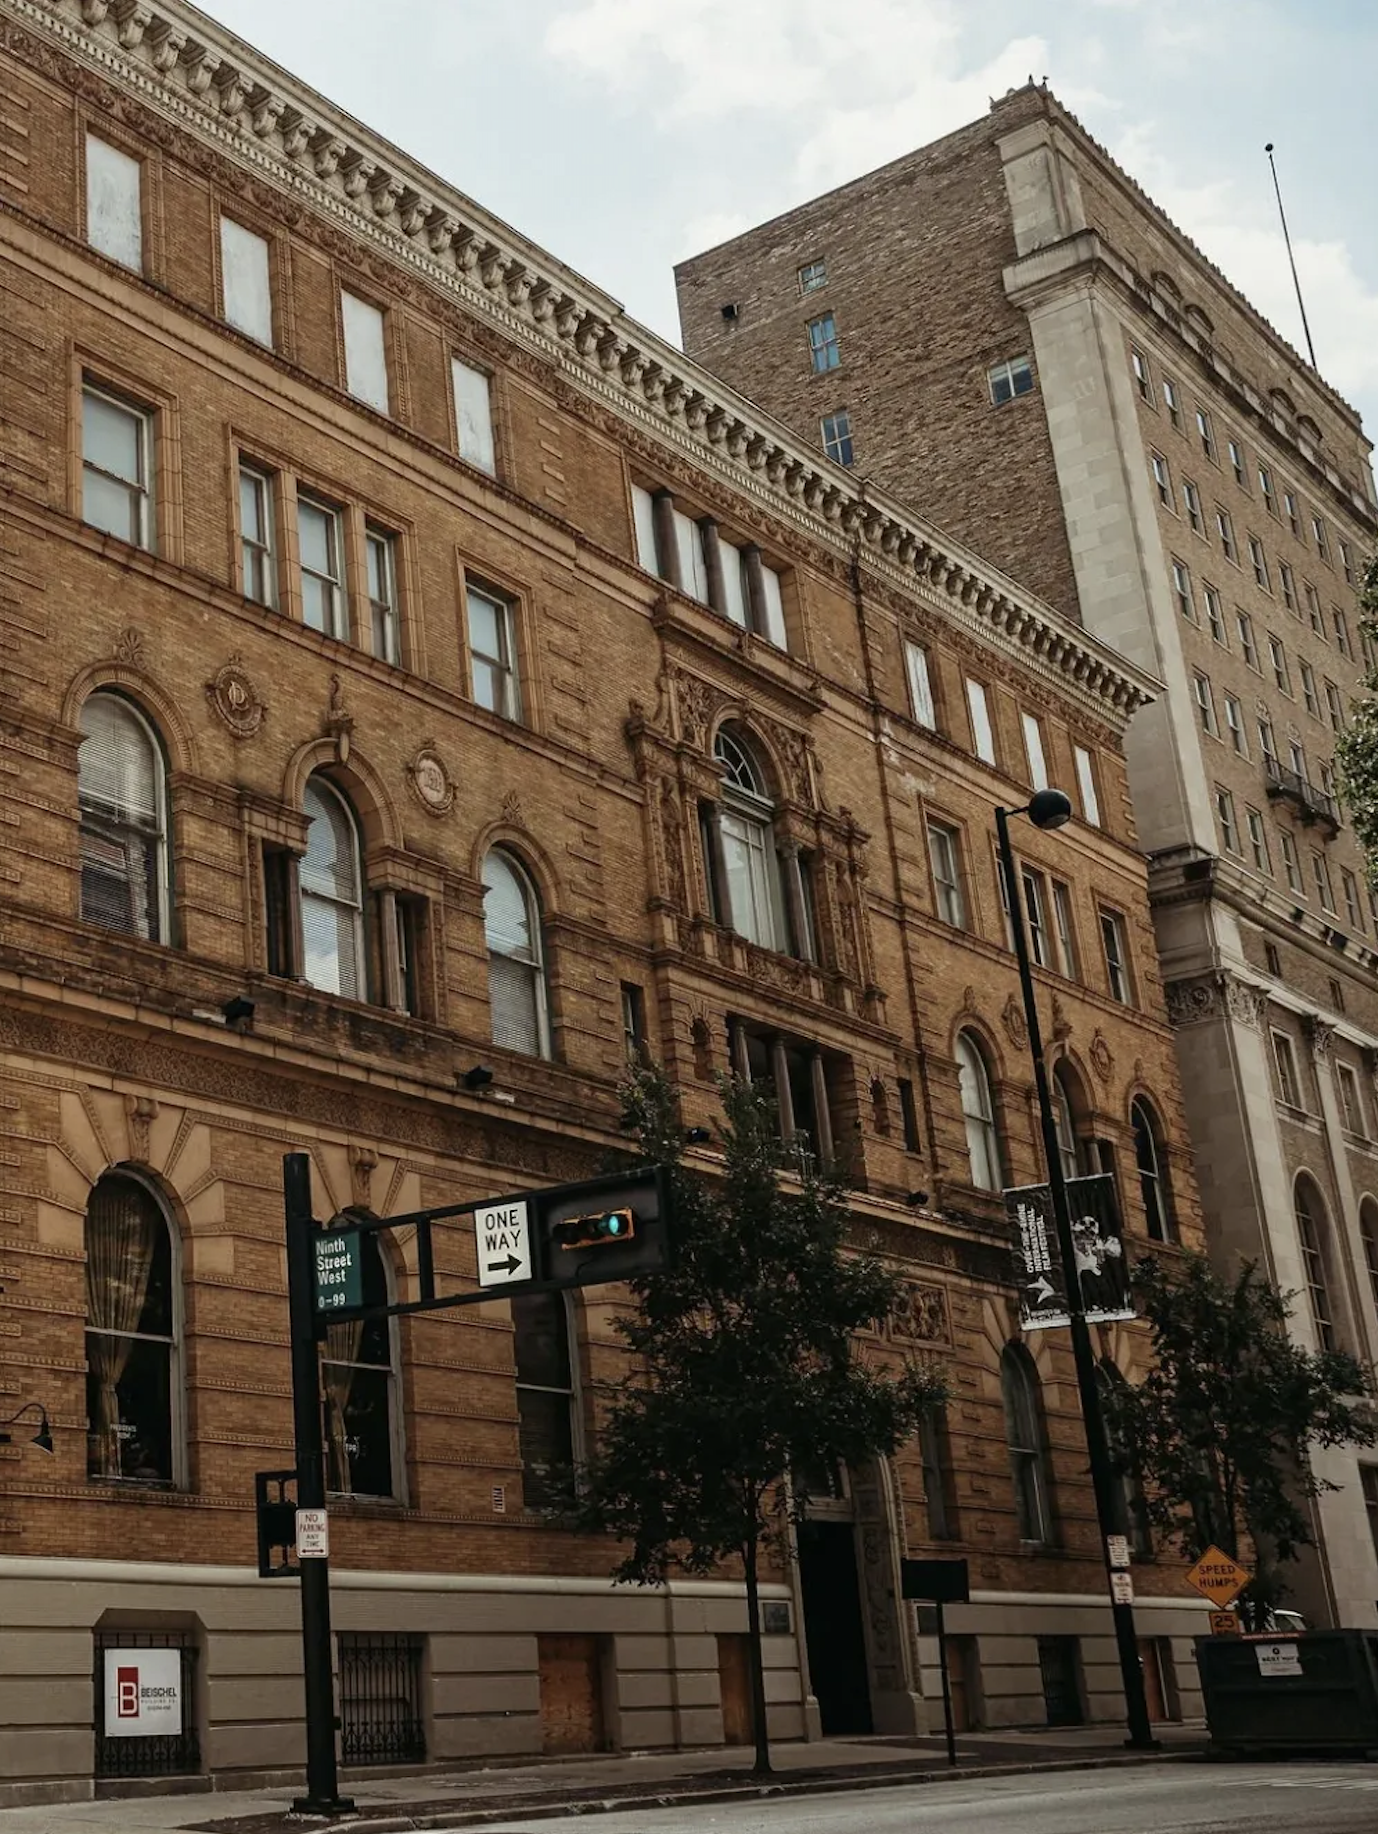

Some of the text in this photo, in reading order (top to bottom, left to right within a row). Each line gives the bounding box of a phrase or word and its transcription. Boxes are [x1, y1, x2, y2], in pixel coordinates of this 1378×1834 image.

[485, 1209, 519, 1231] ONE
[315, 1239, 346, 1257] Ninth
[485, 1229, 521, 1252] WAY
[1026, 1208, 1043, 1272] INTERNATIONAL
[316, 1253, 352, 1271] Street
[1042, 1251, 1052, 1271] FILM
[317, 1270, 346, 1286] West
[318, 1293, 346, 1309] 0-99
[305, 1514, 318, 1522] NO
[299, 1524, 325, 1533] PARKING
[1198, 1565, 1236, 1575] SPEED
[1199, 1578, 1239, 1588] HUMPS
[1214, 1615, 1235, 1627] 25
[119, 1682, 138, 1715] B
[140, 1687, 177, 1697] BEISCHEL
